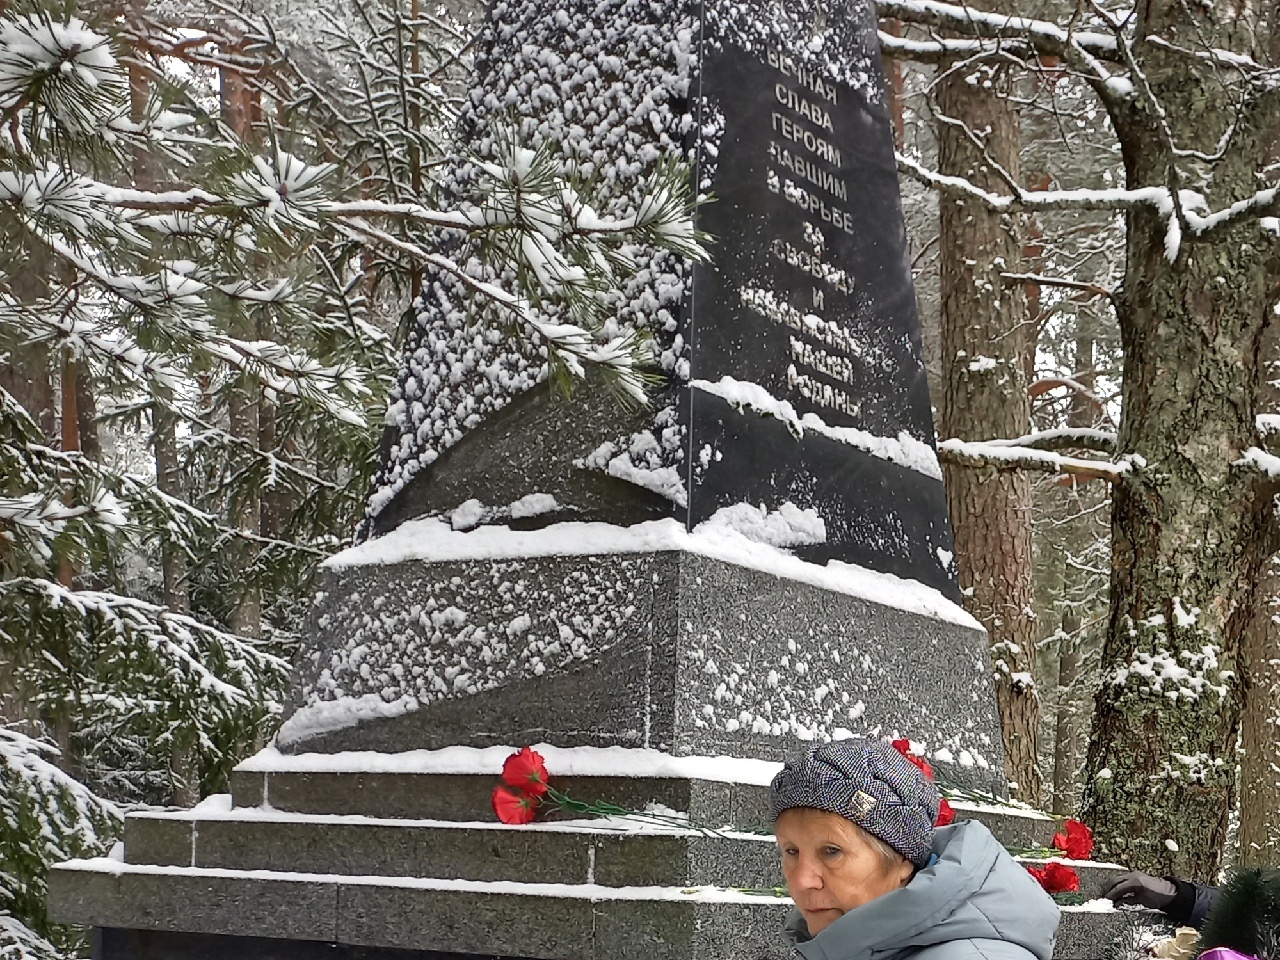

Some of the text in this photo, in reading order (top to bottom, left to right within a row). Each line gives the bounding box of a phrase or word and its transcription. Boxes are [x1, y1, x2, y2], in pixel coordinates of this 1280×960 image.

[775, 83, 834, 133] СЛАВА
[771, 112, 842, 168] ГЕРОЯМ
[771, 238, 855, 296] СВОБДУ
[812, 286, 825, 311] И
